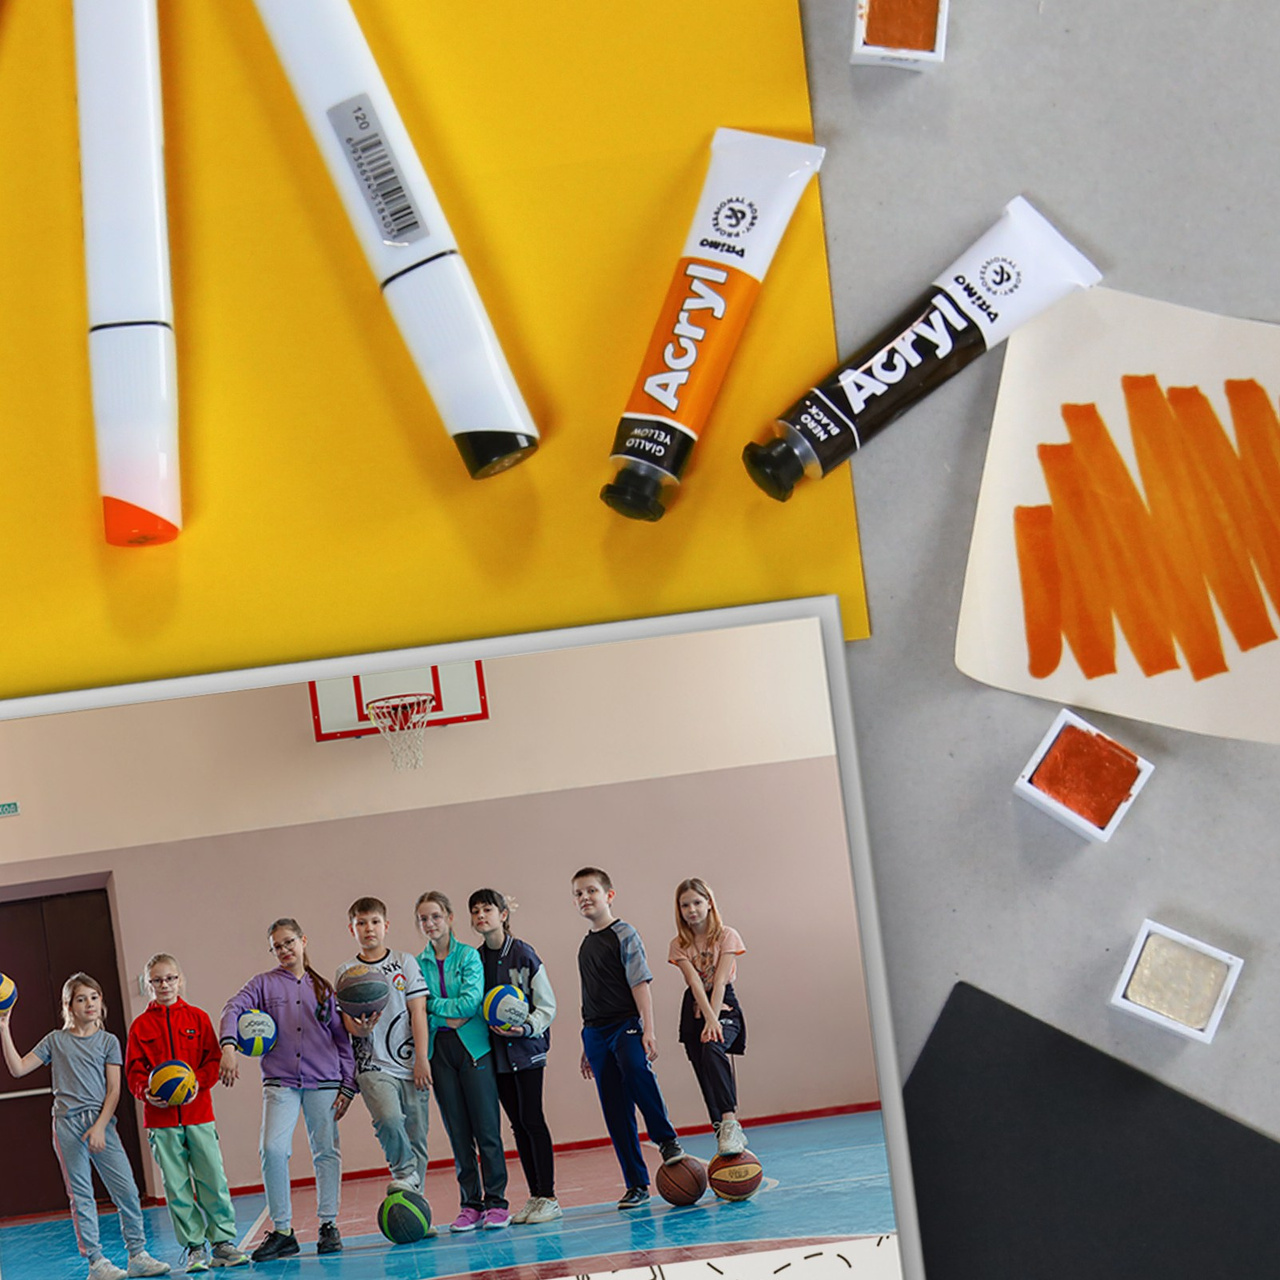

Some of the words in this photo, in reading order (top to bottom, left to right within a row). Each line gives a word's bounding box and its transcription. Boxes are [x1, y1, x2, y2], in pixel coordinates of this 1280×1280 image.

[353, 106, 370, 130] 120
[642, 263, 728, 413] Acryl
[837, 293, 969, 415] Acryl
[800, 413, 829, 442] NERO
[808, 405, 841, 436] BLACK
[625, 437, 665, 457] GIALLO
[631, 427, 671, 446] YELLOW
